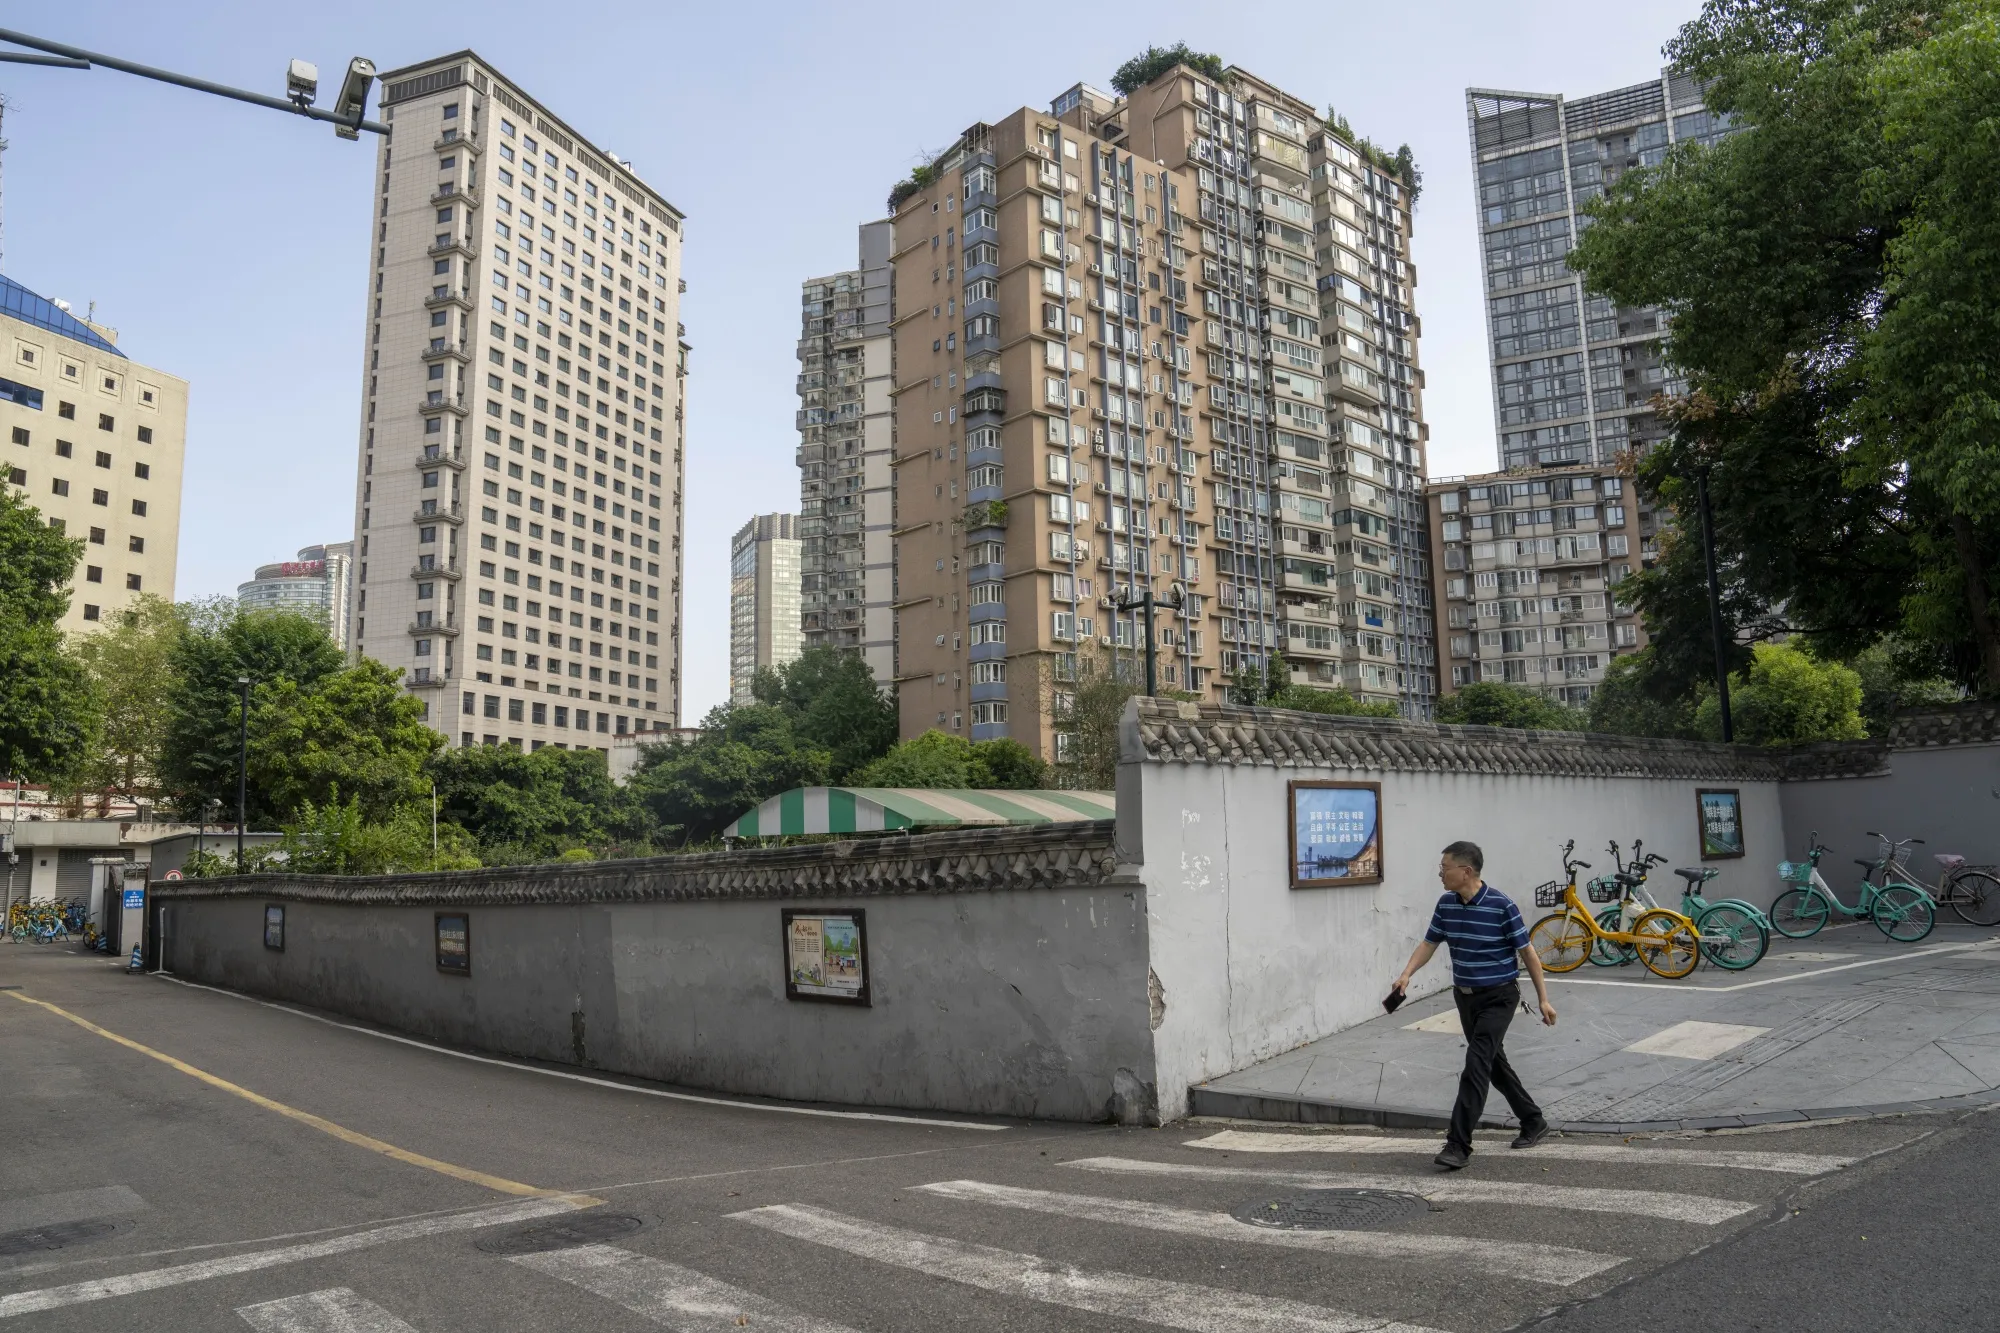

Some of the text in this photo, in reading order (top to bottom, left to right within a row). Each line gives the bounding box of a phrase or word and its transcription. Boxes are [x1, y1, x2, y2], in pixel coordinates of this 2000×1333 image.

[1325, 812, 1336, 820] 民主
[1338, 812, 1350, 820] 文明
[1310, 823, 1322, 832] 自由
[1338, 822, 1350, 831] 公正
[1352, 822, 1364, 831] 法治
